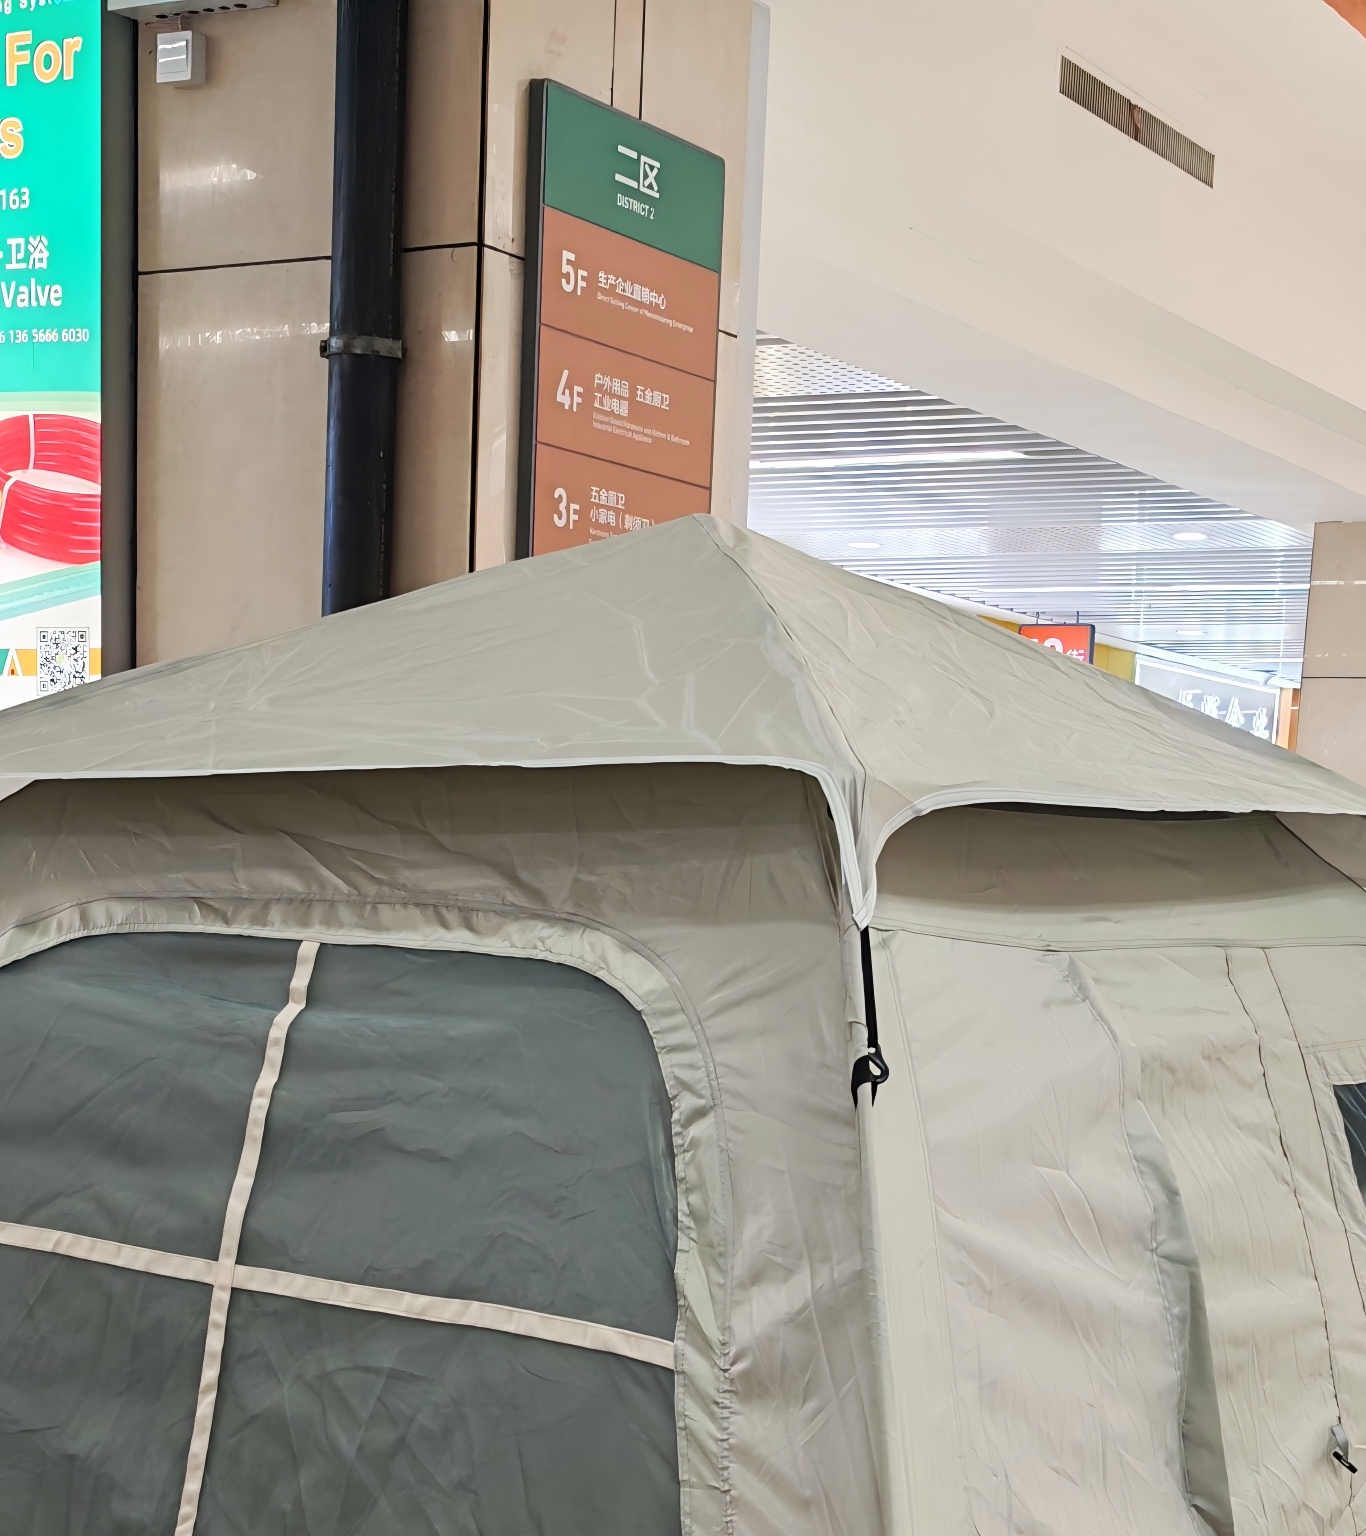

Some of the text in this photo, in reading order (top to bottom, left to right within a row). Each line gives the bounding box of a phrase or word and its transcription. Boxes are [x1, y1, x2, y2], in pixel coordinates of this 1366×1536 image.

[5, 30, 83, 87] For
[614, 144, 661, 199] 二区
[617, 193, 655, 220] DISTRICT 2
[561, 249, 588, 296] 5F
[1, 277, 63, 308] Valve
[9, 329, 29, 344] 136
[61, 327, 90, 342] 6030
[556, 369, 584, 412] 4F
[593, 392, 629, 417] 工业电器
[594, 372, 670, 411] 户外用品 五金厨卫
[553, 487, 580, 530] 3F
[590, 486, 626, 510] 五金厨卫
